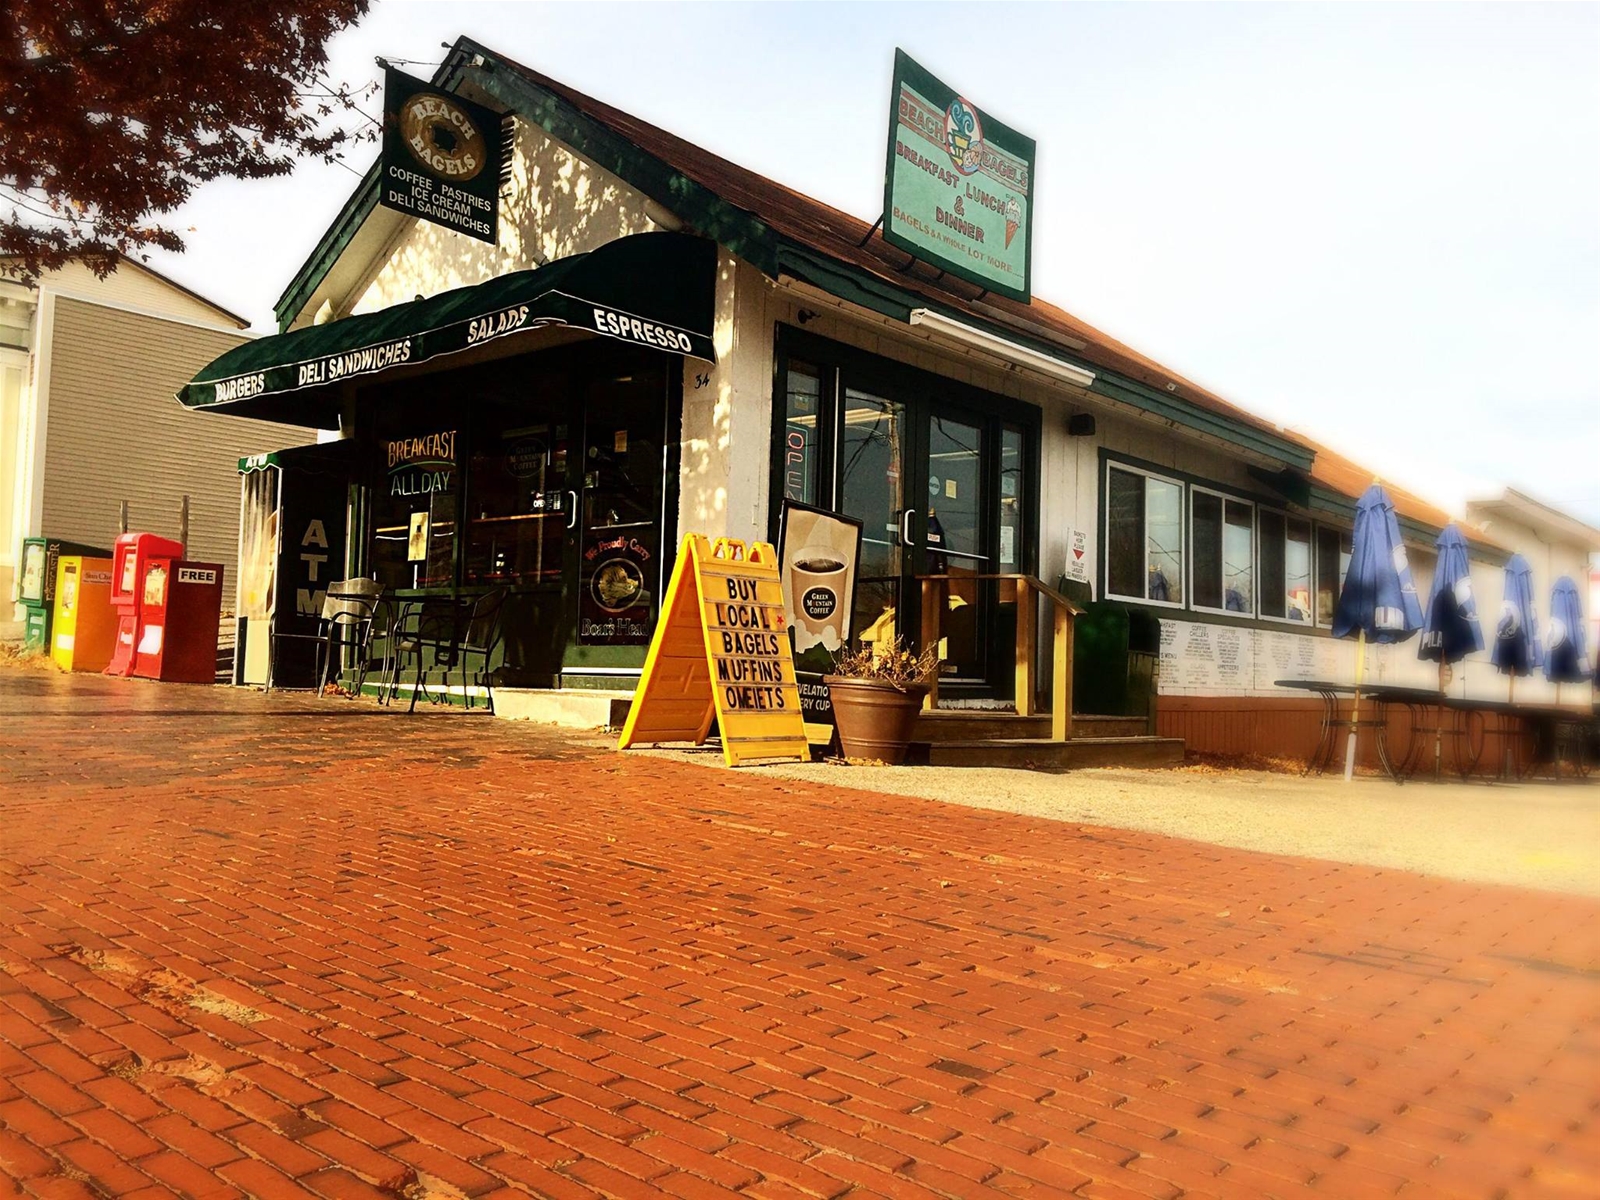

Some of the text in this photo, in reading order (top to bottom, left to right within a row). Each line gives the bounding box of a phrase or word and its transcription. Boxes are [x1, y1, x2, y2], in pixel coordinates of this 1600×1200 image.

[411, 101, 475, 140] BEACH
[899, 97, 944, 143] BEACH
[410, 135, 476, 175] BAGELS
[982, 151, 1027, 187] BAGELS
[389, 166, 491, 212] COFFEE PASTRIES
[411, 186, 471, 216] ICE CREAM
[389, 191, 490, 235] DELI SANDWICHES
[954, 195, 965, 217] &
[893, 207, 930, 234] BAGELS
[943, 235, 966, 251] WHOLE
[968, 247, 985, 260] LOT
[936, 206, 985, 243] DINNER
[467, 306, 529, 343] SALADS
[593, 308, 692, 352] ESPRESSO
[298, 340, 411, 386] DELI SANDWICHES
[215, 373, 265, 402] BURGERS
[388, 430, 457, 468] BREAKFAST
[391, 471, 451, 496] ALL DAY
[585, 536, 651, 561] We Proudly Carry
[180, 571, 213, 581] FREE
[297, 519, 328, 614] ATM
[726, 577, 757, 601] BUY
[581, 617, 649, 637] Boar's Head
[715, 602, 770, 629] LOCAL
[722, 631, 779, 655] BAGELS
[717, 659, 782, 682] MUFFINS
[798, 683, 829, 697] VELATIO
[800, 697, 831, 711] ERY CUP
